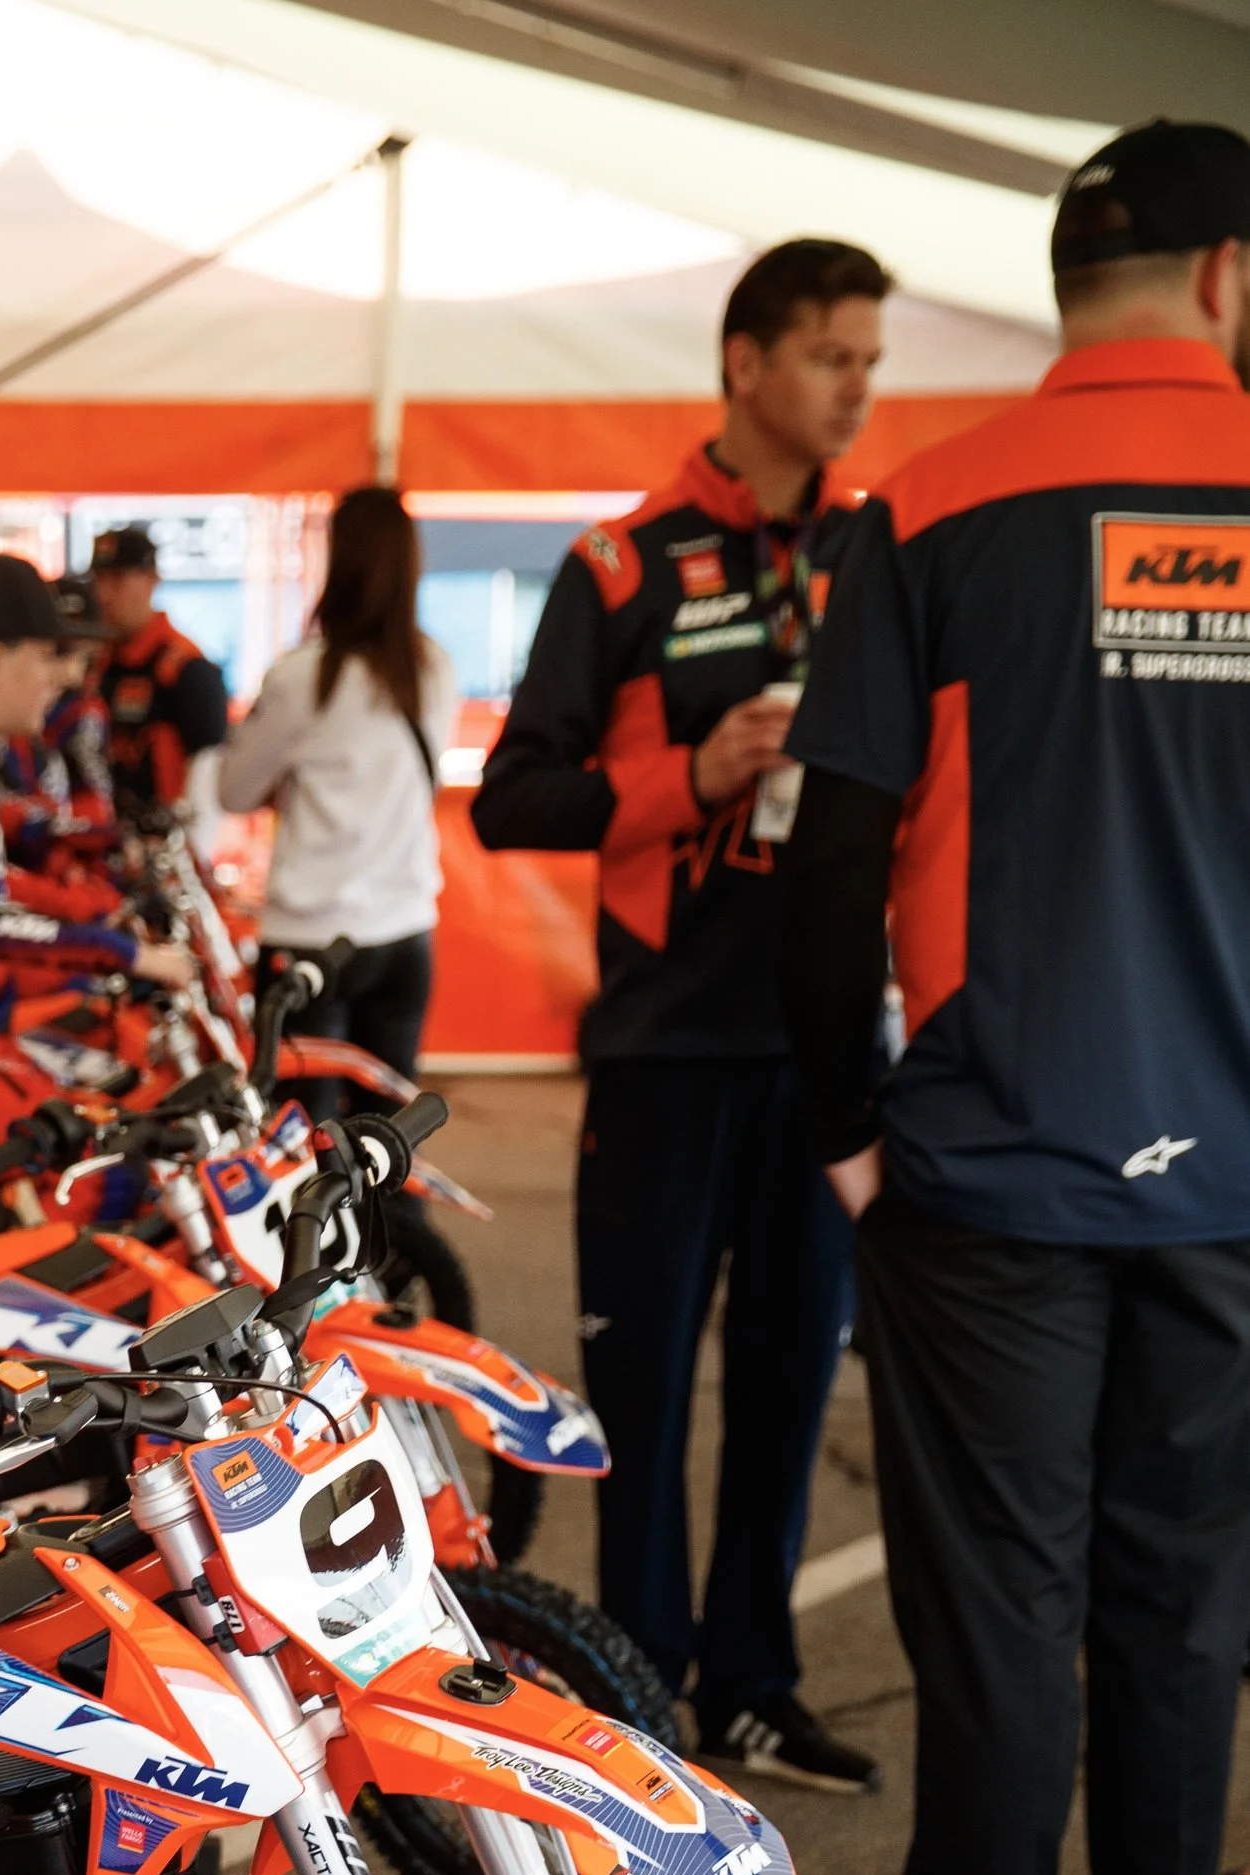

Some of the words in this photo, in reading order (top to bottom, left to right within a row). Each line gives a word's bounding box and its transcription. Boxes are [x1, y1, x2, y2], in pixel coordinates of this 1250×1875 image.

[1125, 545, 1242, 586] KTM
[223, 1459, 250, 1483] KTM
[300, 1459, 414, 1639] 9
[134, 1756, 250, 1810] KTM
[471, 1745, 504, 1770] Troy
[503, 1752, 532, 1773] Lee
[533, 1766, 602, 1802] Designs
[298, 1823, 331, 1875] XACT
